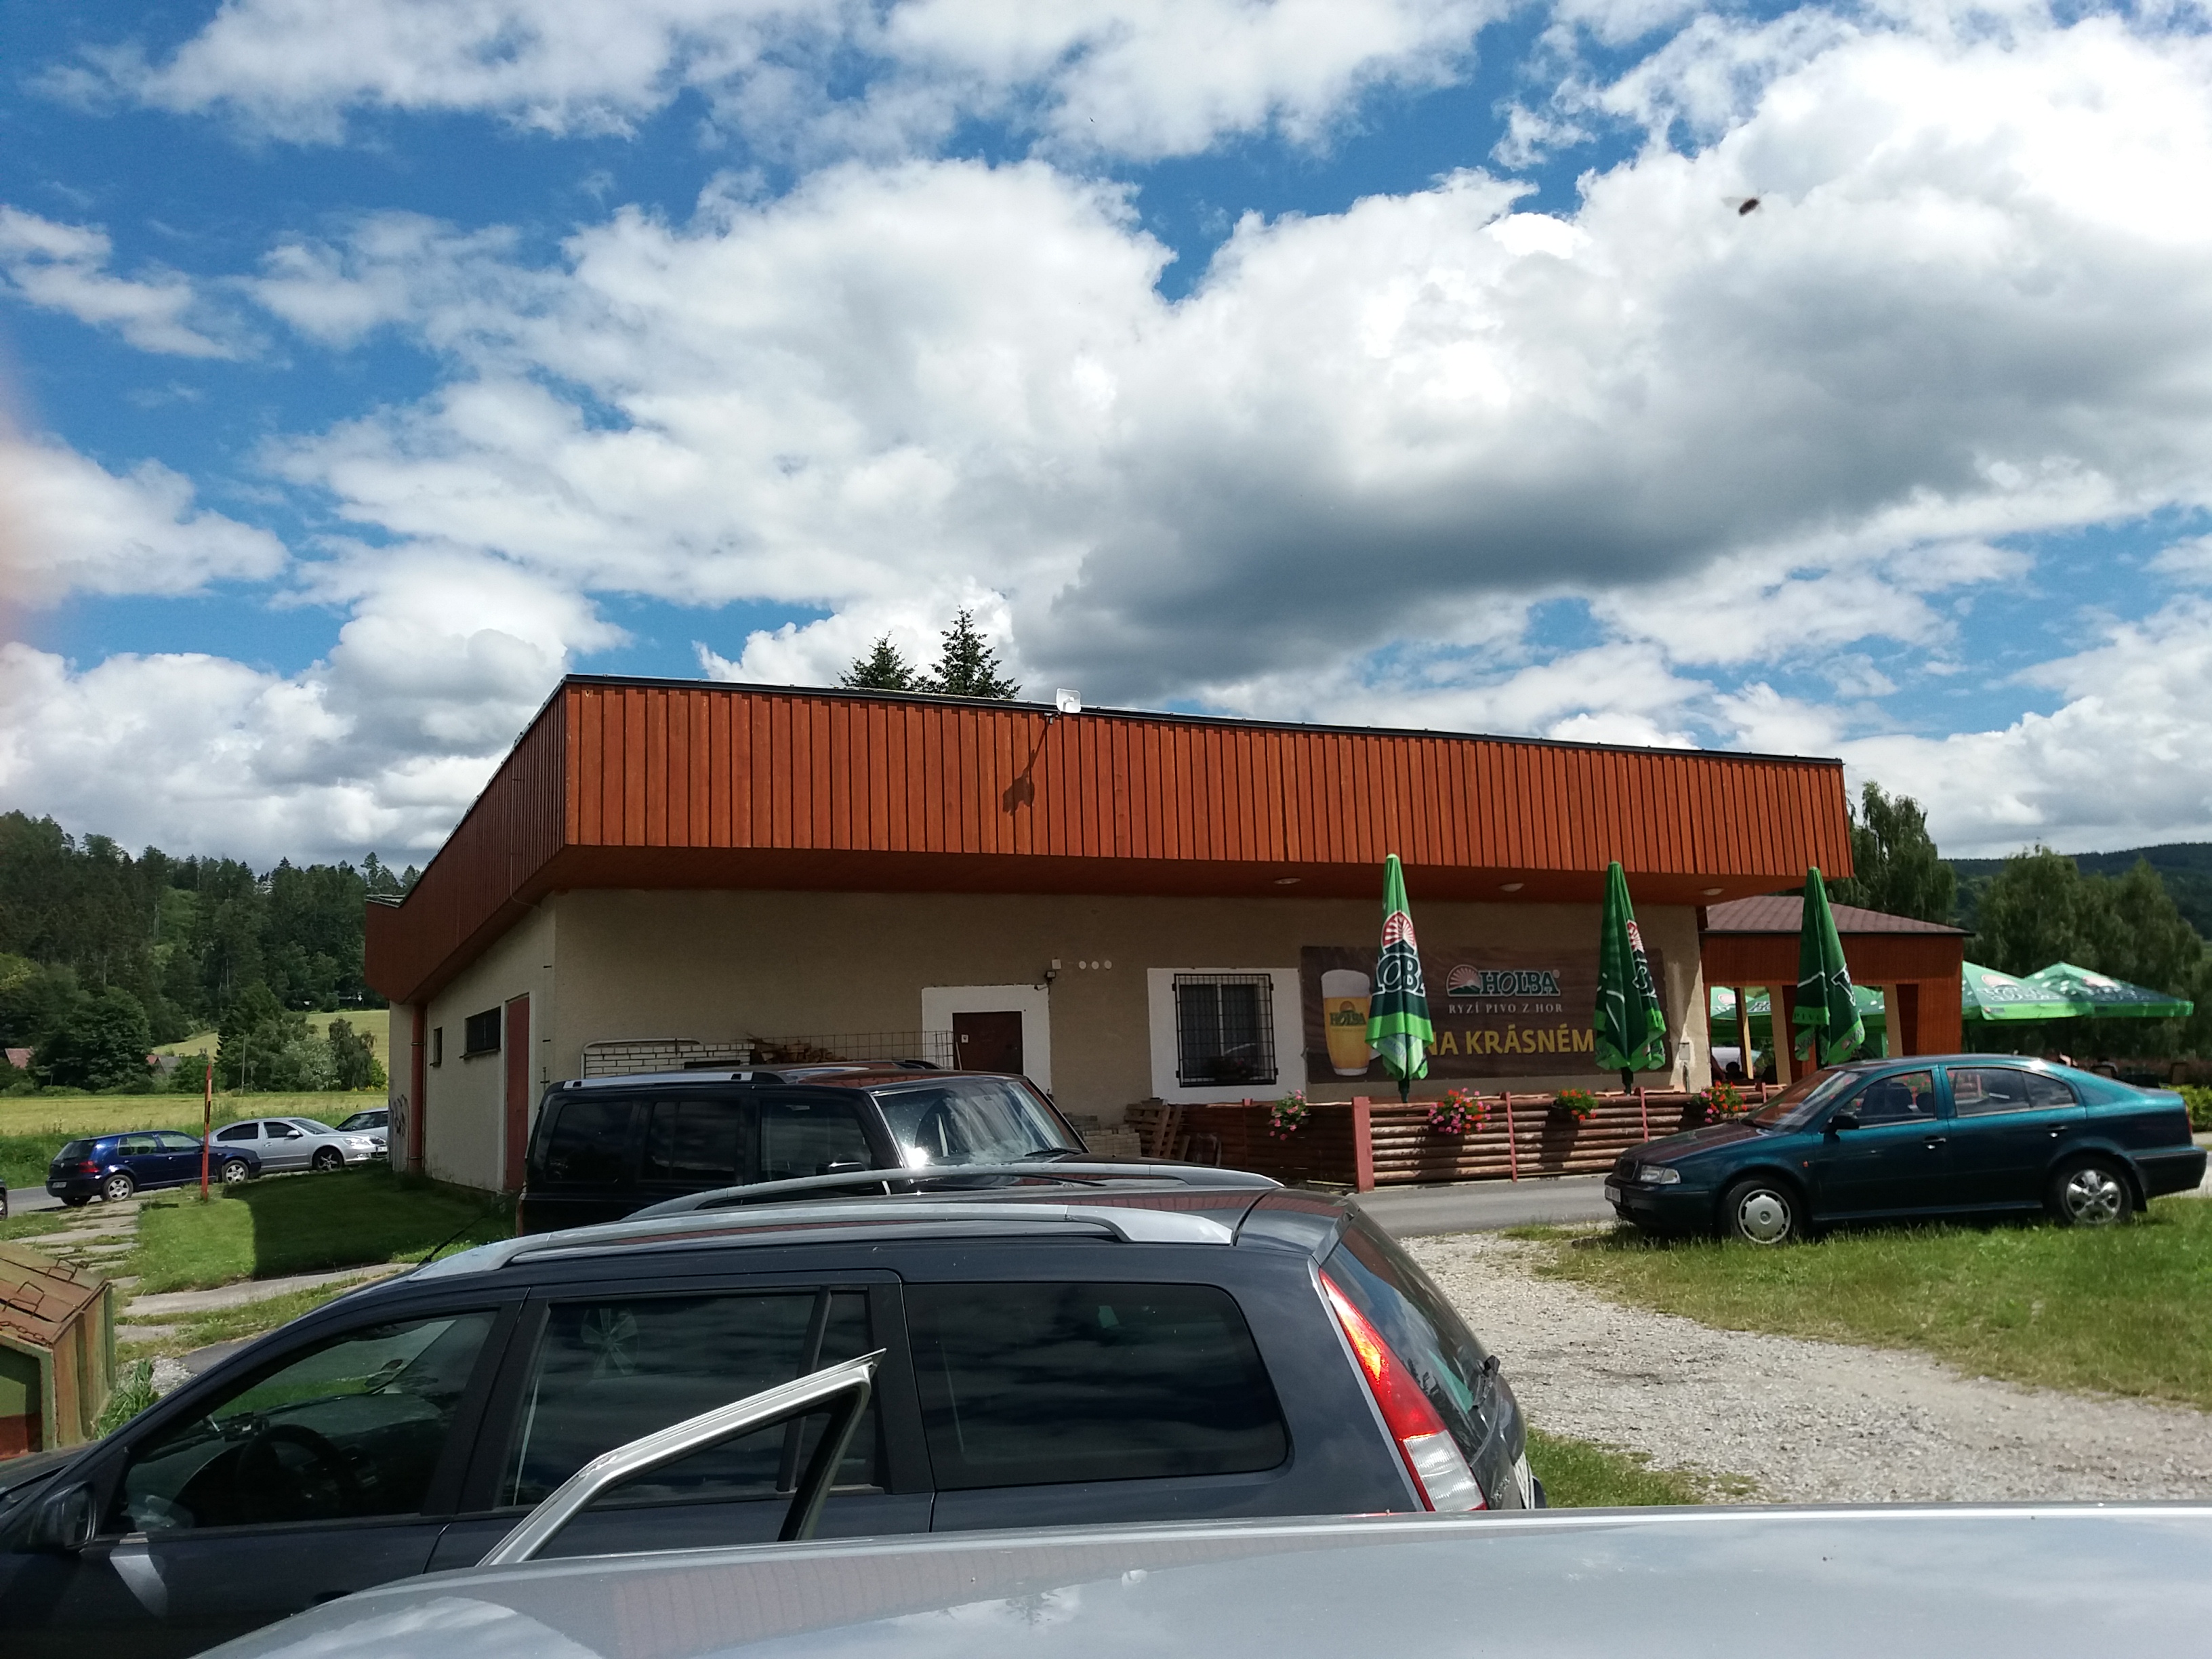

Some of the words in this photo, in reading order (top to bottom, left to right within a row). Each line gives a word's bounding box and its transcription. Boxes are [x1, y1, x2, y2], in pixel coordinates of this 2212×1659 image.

[1478, 970, 1560, 996] HOLBA
[1449, 1002, 1479, 1014] RYZÍ
[1486, 1003, 1516, 1013] PIVO
[1522, 1004, 1530, 1012] Z
[1536, 1003, 1563, 1013] HOR
[1465, 1023, 1595, 1055] KRÁSNÉM
